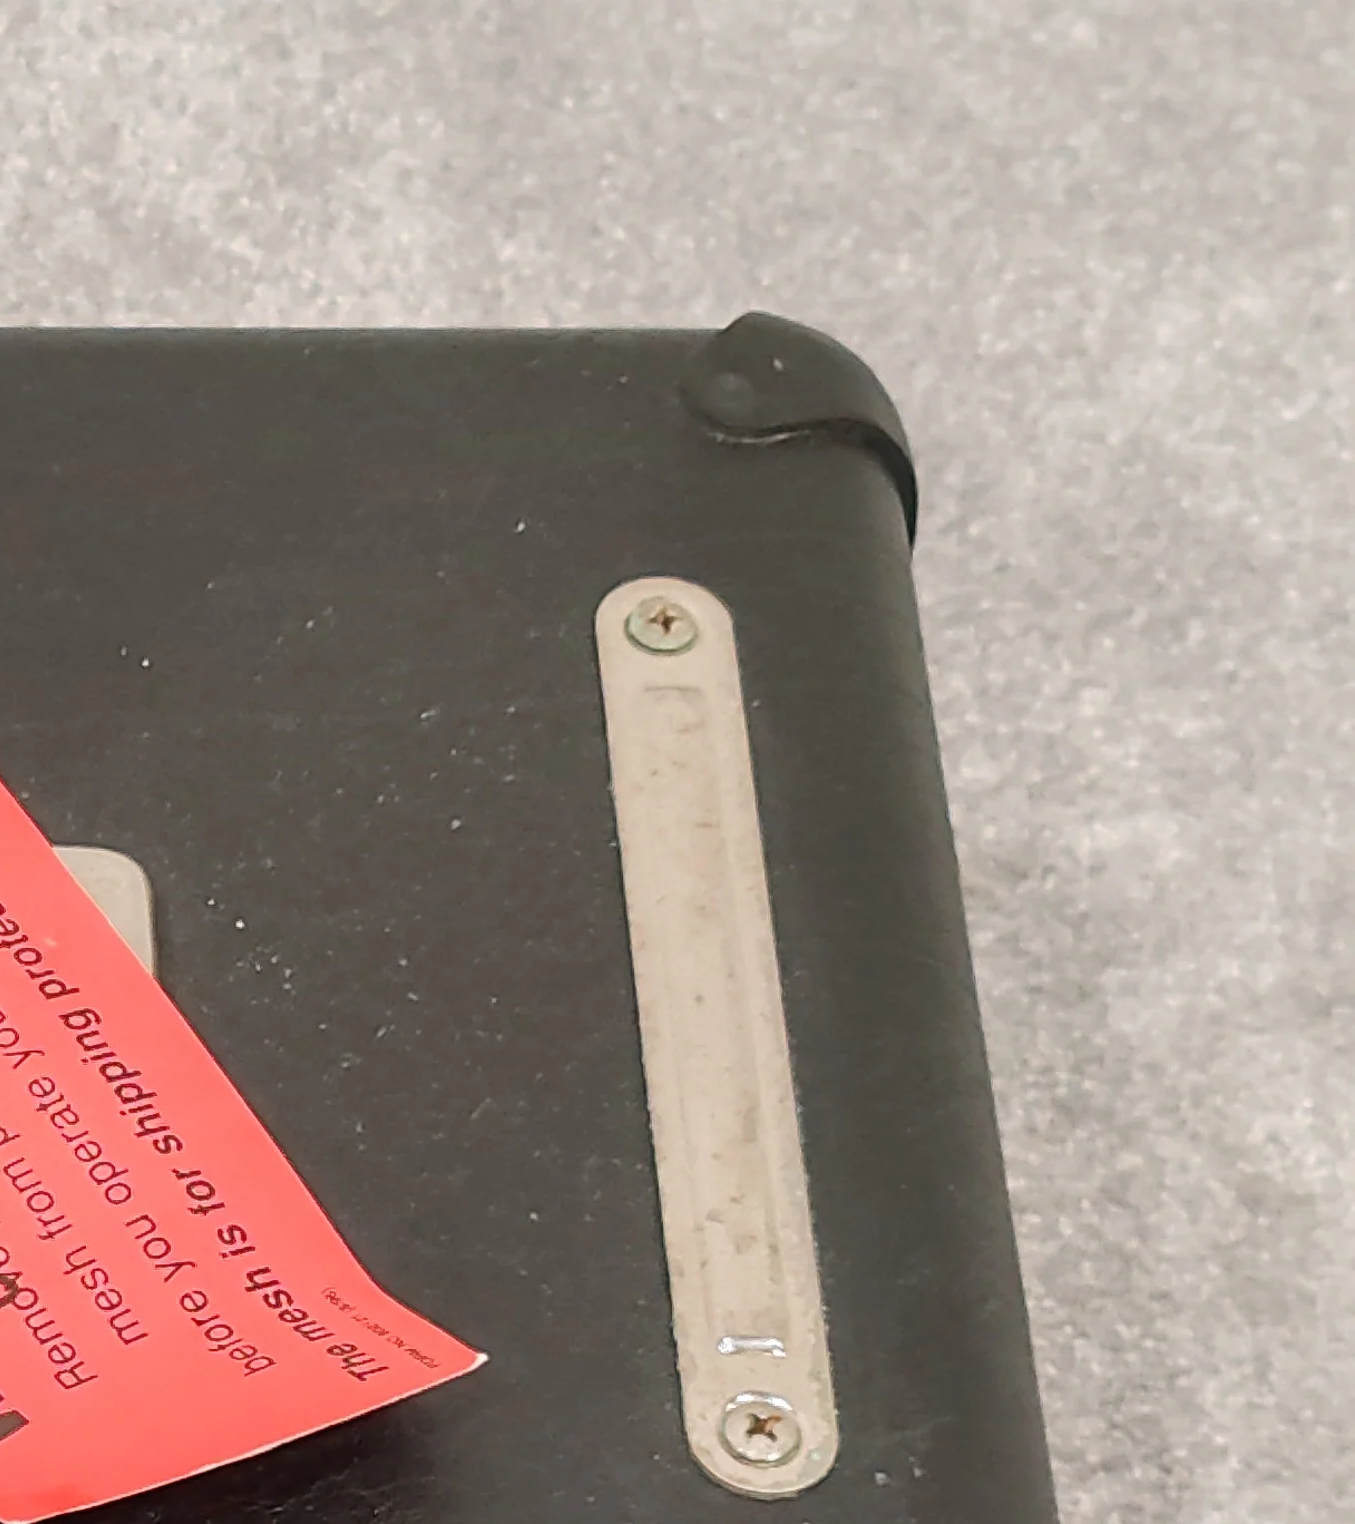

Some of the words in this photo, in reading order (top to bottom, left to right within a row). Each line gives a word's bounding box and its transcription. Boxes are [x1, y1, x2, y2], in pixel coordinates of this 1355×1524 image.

[58, 1007, 183, 1154] shipping
[28, 1076, 132, 1205] operate
[2, 1157, 73, 1241] from
[171, 1168, 225, 1216] for
[125, 1214, 196, 1282] you
[217, 1224, 256, 1259] is
[63, 1245, 149, 1345] mesh
[179, 1290, 276, 1377] before
[244, 1267, 336, 1341] mesh
[326, 1343, 389, 1382] The
